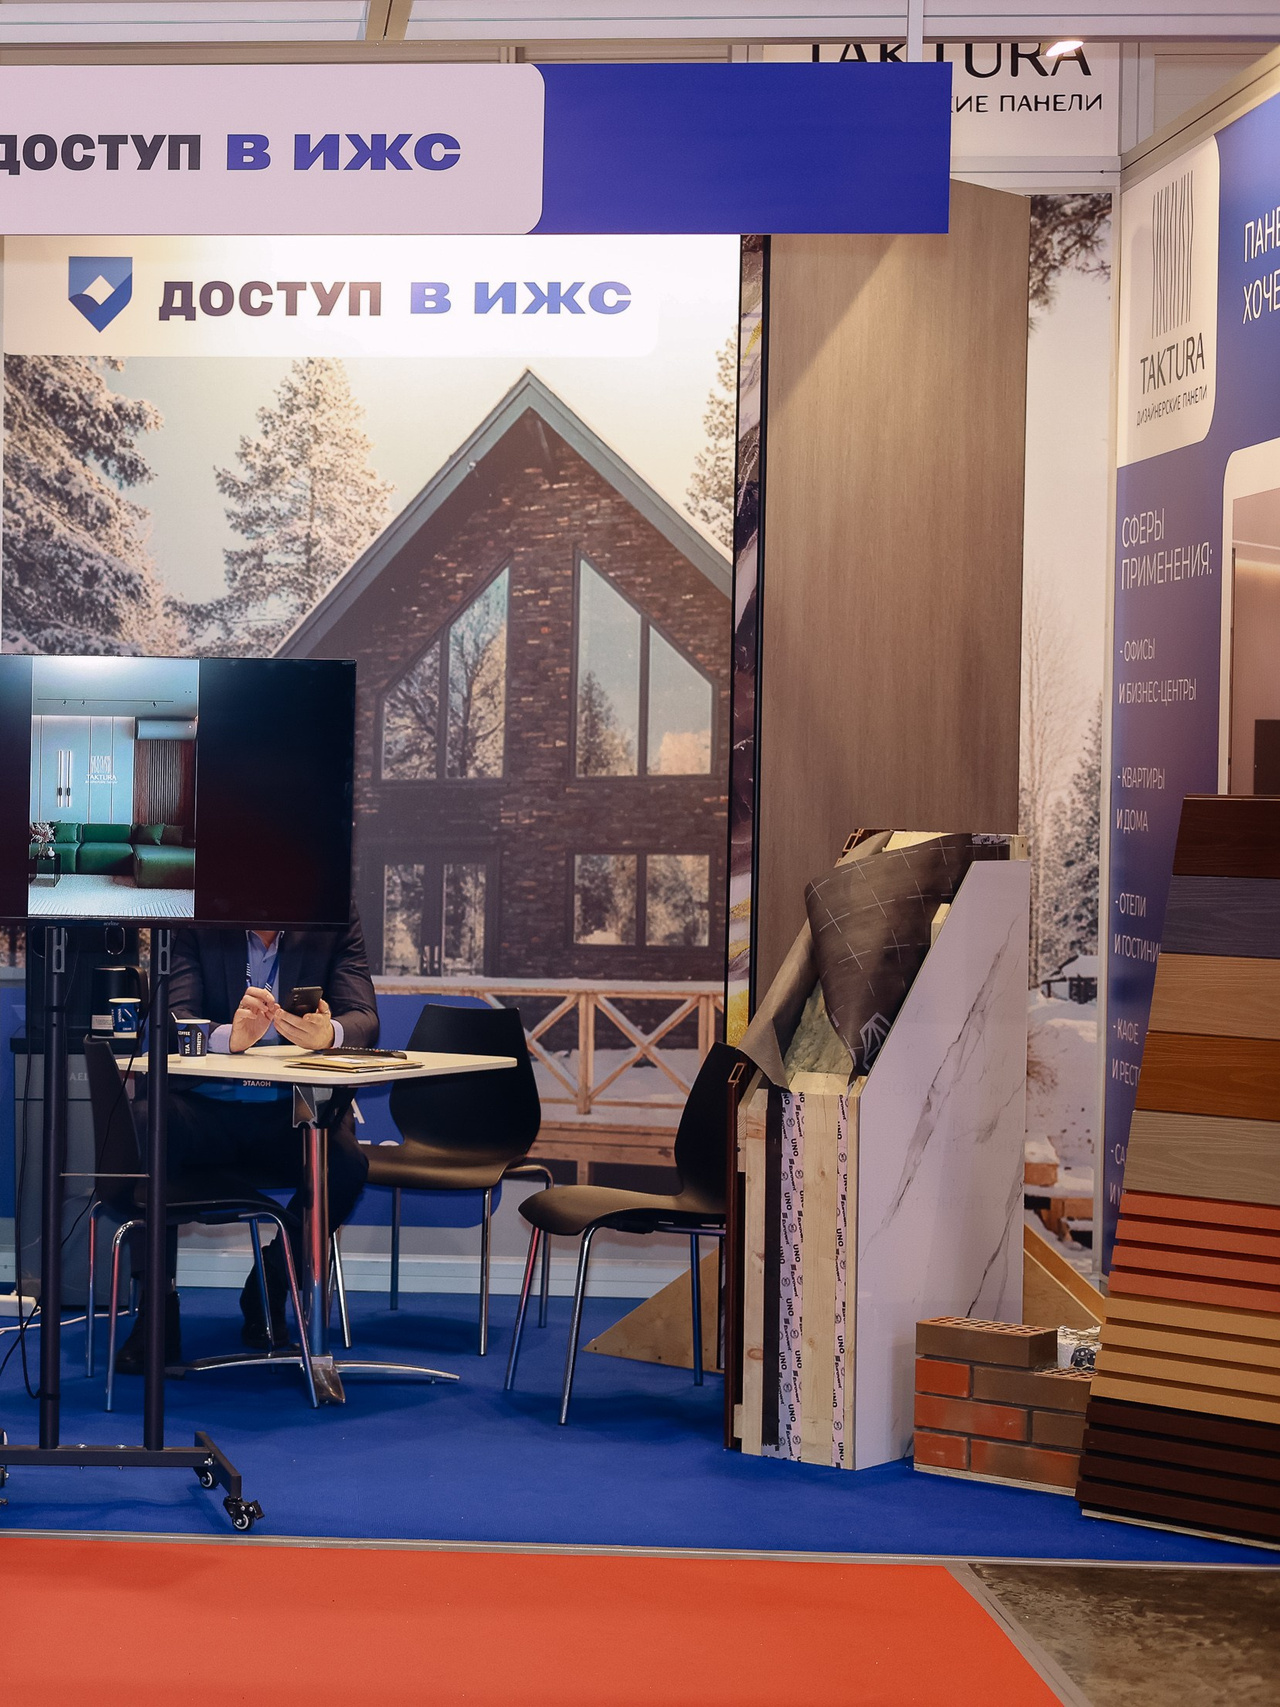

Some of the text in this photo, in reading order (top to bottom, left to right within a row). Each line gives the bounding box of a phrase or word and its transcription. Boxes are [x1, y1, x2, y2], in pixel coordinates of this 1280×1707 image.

[951, 94, 1102, 113] ИЕ ПАНЕЛИ
[226, 134, 271, 171] В
[294, 132, 461, 171] ИЖС
[158, 280, 632, 321] ДОСТУП В ИЖС
[1140, 332, 1205, 394] TAKTURA
[1137, 384, 1208, 426] ДИЗАЙНЕРСКИЕ ПАНЕЛИ
[1122, 508, 1165, 548] СФЕРЫ
[1121, 541, 1214, 590] ПРИМЕНЕНИЯ:
[1126, 678, 1197, 706] БИЗНЕС-ЦЕНТРЫ
[1124, 810, 1148, 834] ДОМА
[1122, 935, 1161, 962] ГОСТИНИ
[790, 1138, 798, 1157] UNO
[784, 1192, 792, 1211] UNO
[836, 1228, 844, 1247] UNO
[793, 1244, 801, 1263] UNO
[786, 1298, 794, 1317] UNO
[837, 1335, 845, 1354] UNO
[779, 1352, 788, 1370] UNO
[794, 1350, 802, 1369] UNO
[788, 1404, 796, 1422] UNO
